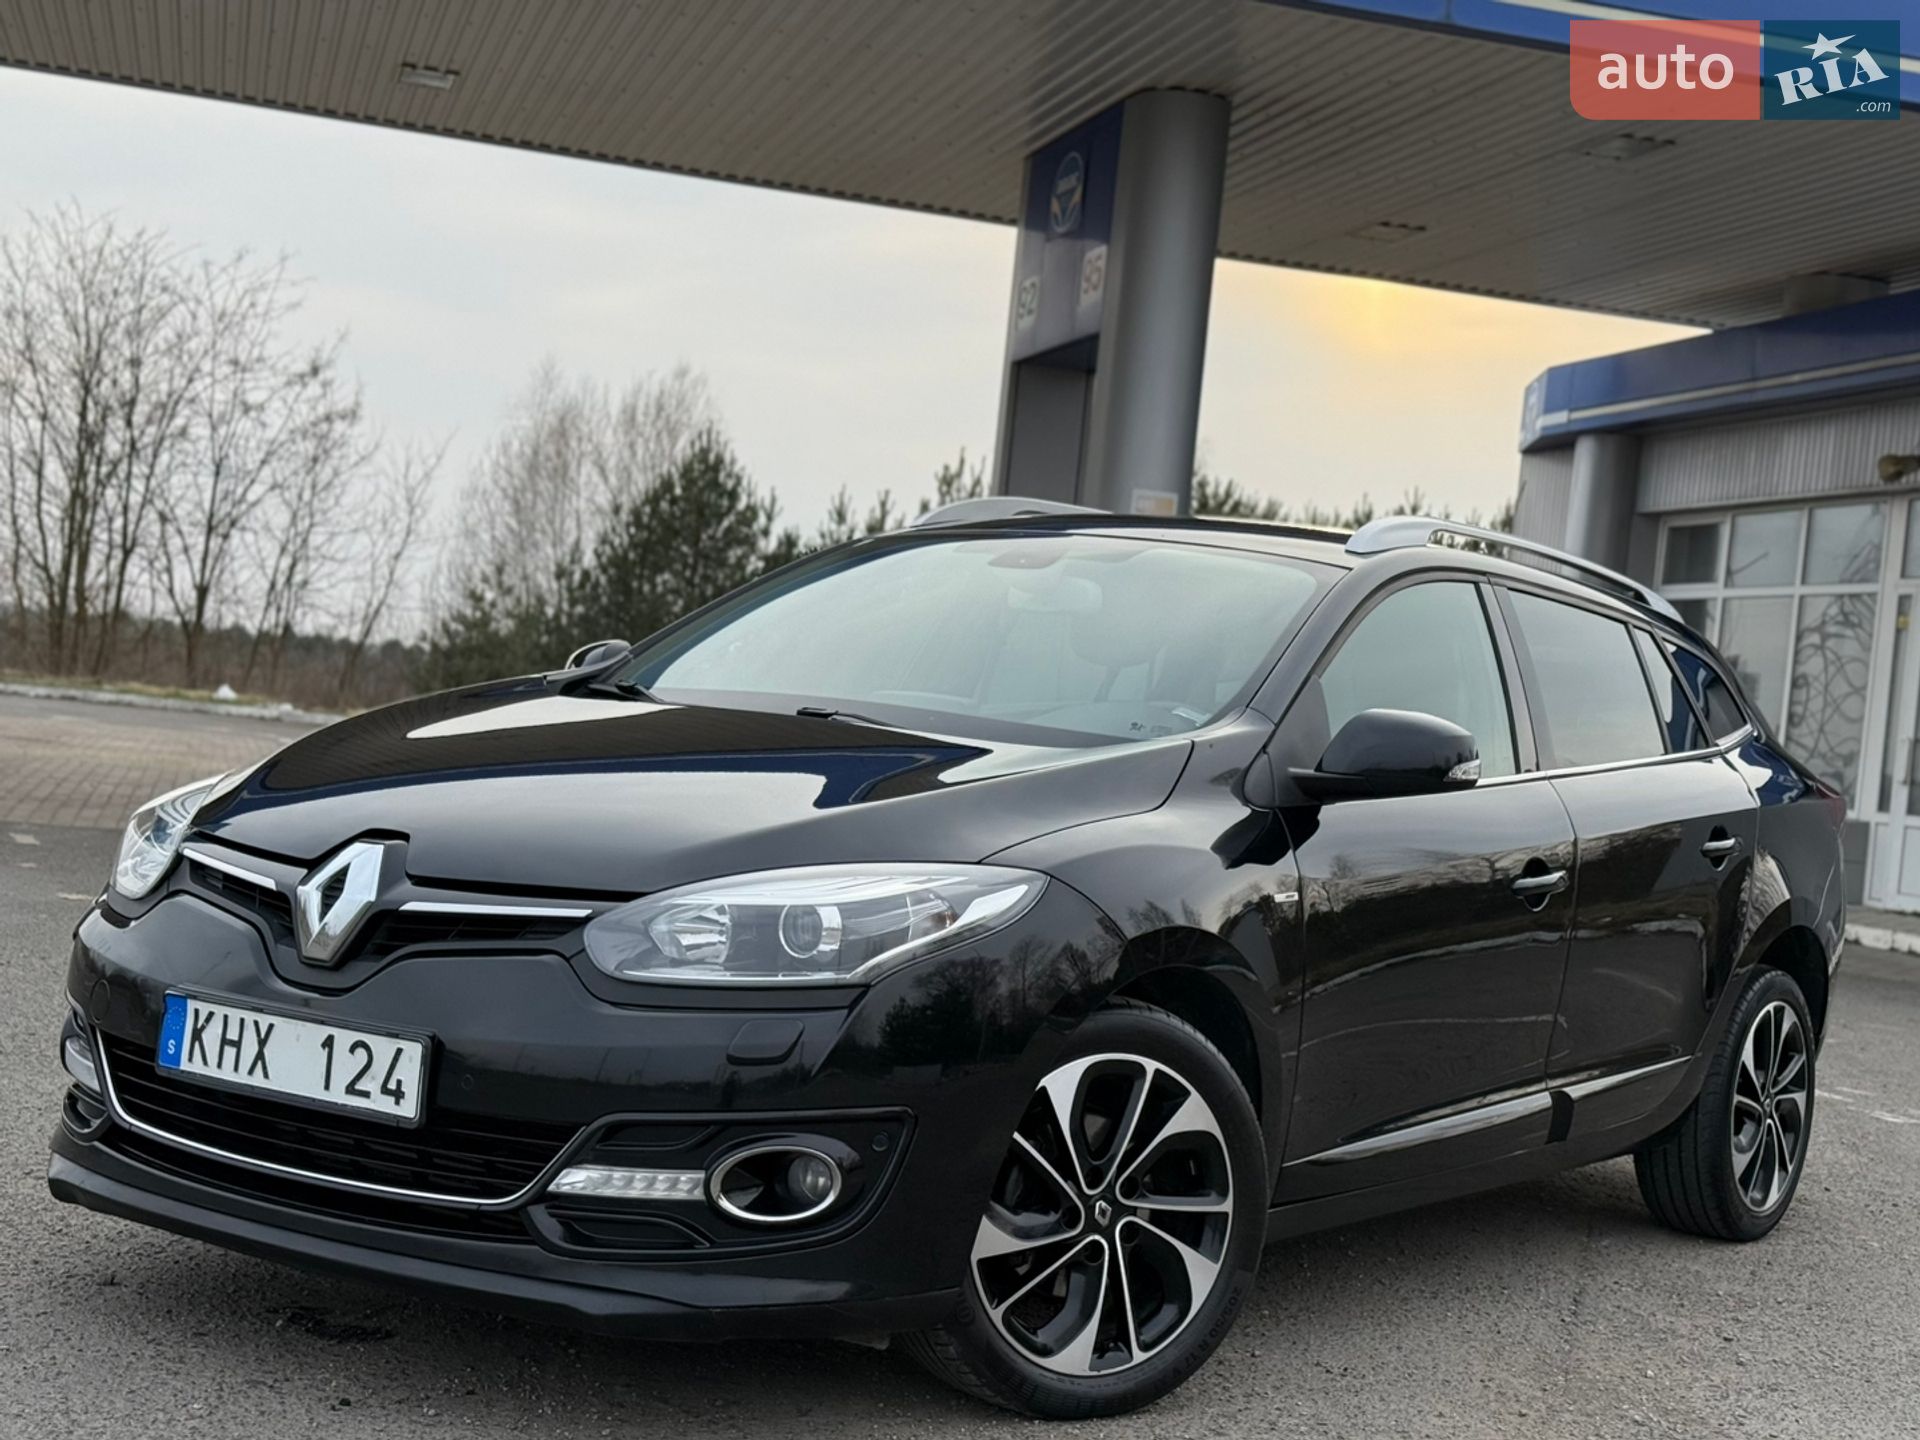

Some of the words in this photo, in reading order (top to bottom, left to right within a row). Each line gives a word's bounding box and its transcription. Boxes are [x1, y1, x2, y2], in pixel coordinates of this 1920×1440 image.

[167, 1039, 177, 1055] S
[187, 1007, 275, 1081] KHX
[320, 1033, 406, 1106] 124
